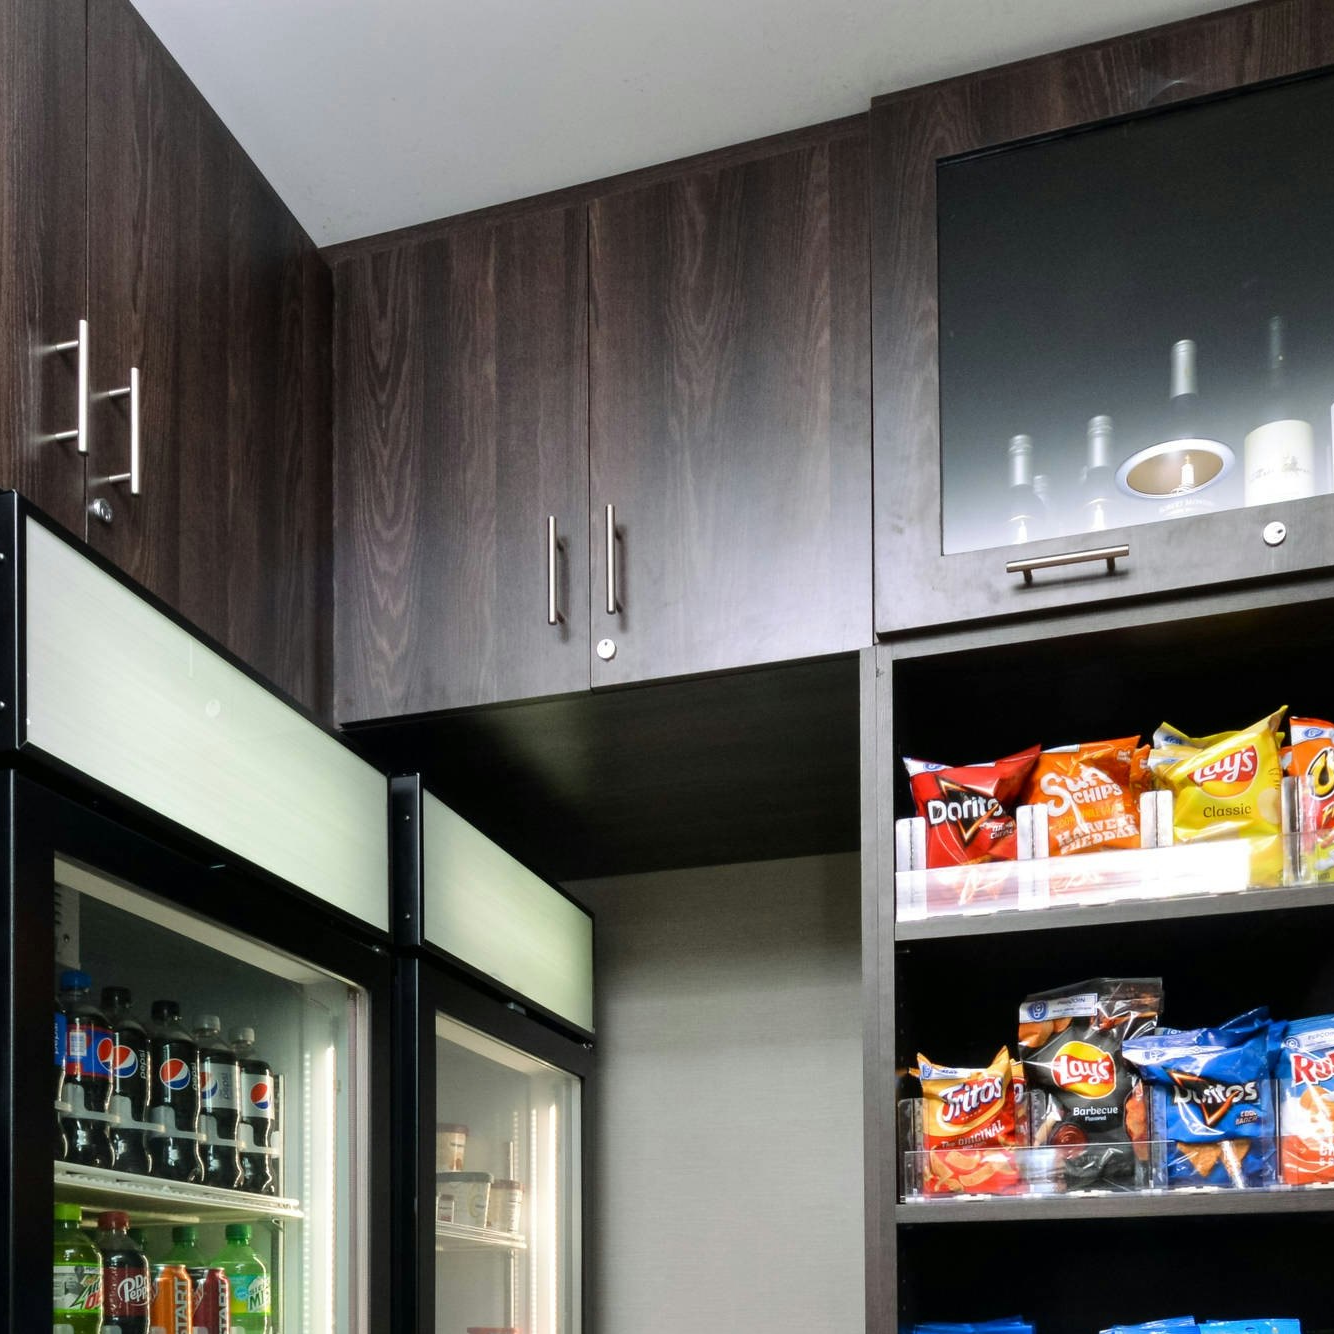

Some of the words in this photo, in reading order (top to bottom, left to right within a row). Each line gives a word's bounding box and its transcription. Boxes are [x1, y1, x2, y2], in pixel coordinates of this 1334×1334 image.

[1191, 746, 1257, 786] Lay's
[1039, 763, 1114, 817] Sun
[1072, 783, 1123, 804] CHIPS
[927, 796, 1002, 825] Doritos
[1202, 802, 1252, 819] Classic
[1053, 1053, 1110, 1087] Lay's
[938, 1076, 1003, 1123] Fritos
[1172, 1080, 1259, 1106] Doritos
[1073, 1107, 1119, 1117] Barbecue
[958, 1120, 1006, 1146] ORIGINAL
